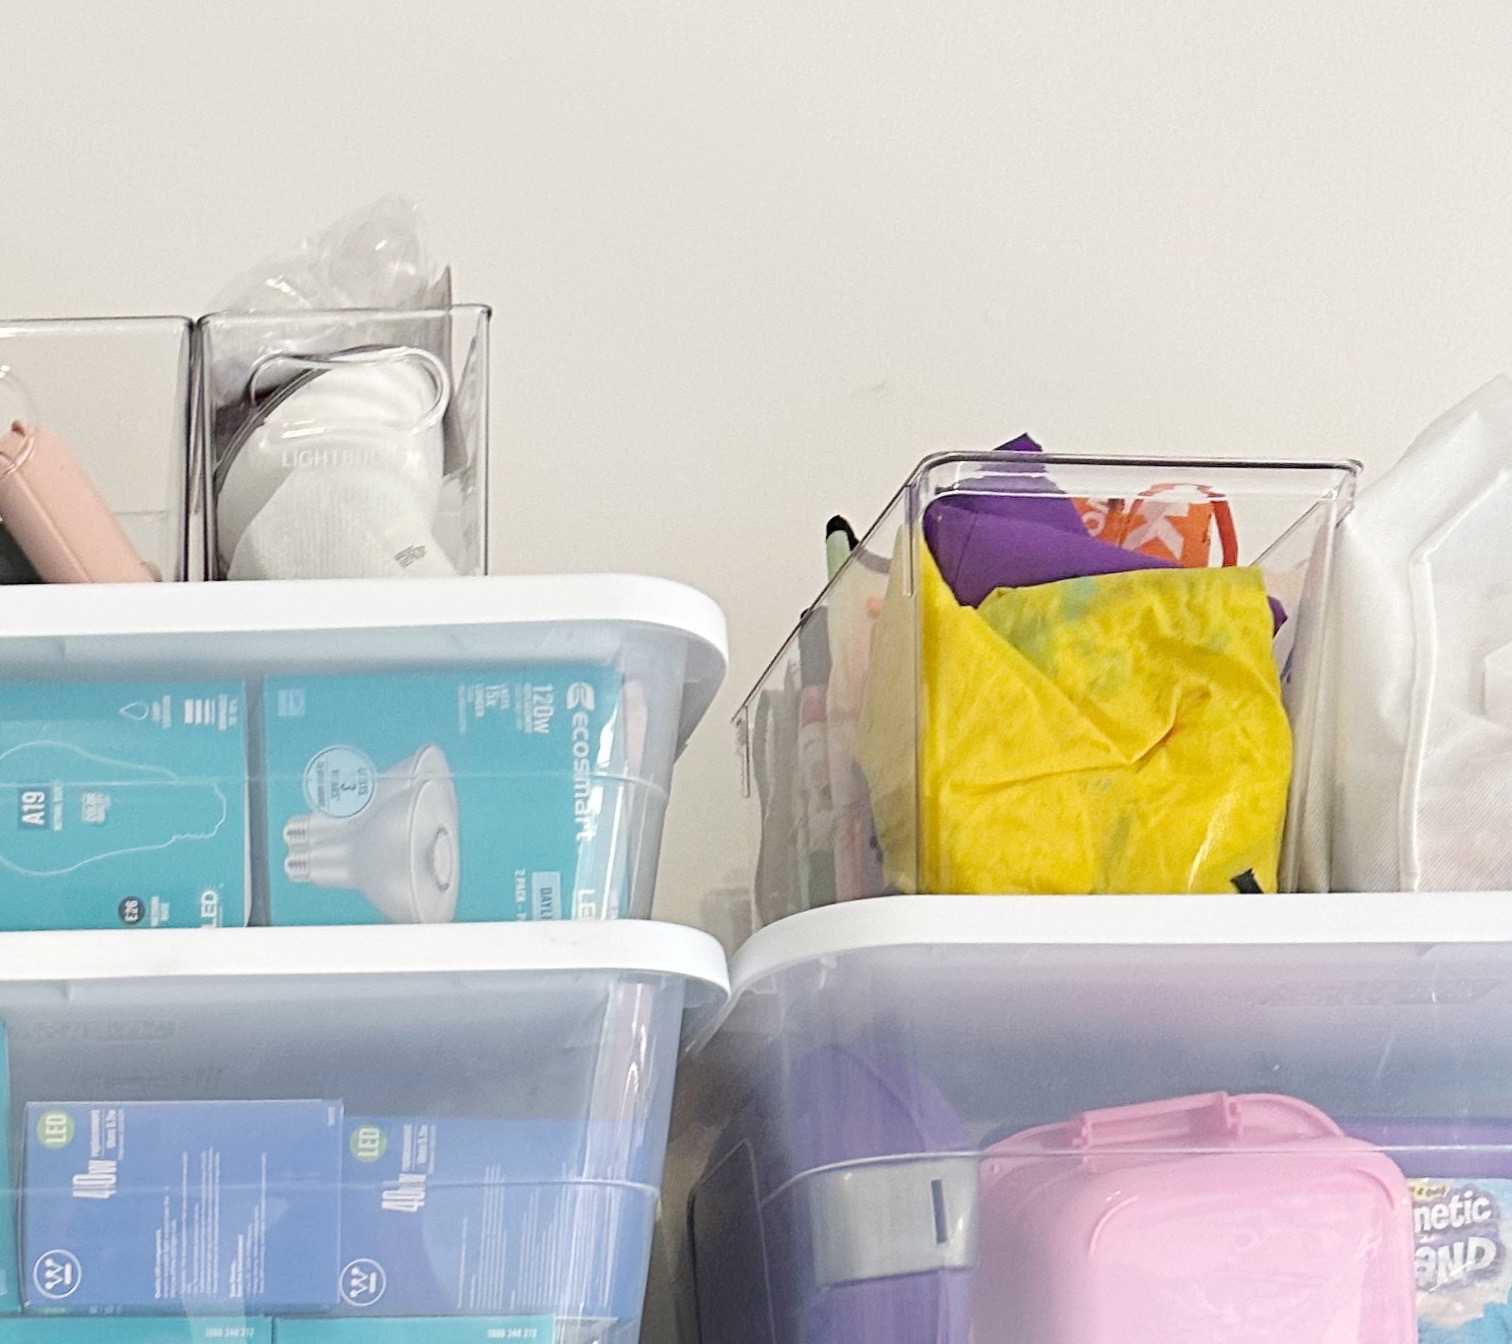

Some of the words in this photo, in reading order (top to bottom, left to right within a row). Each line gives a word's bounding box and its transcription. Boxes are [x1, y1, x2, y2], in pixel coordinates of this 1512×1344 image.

[532, 684, 554, 733] 120w
[571, 712, 596, 841] ecosmart
[22, 791, 45, 826] A19
[201, 890, 217, 928] LED
[577, 888, 595, 919] LE
[45, 1112, 67, 1144] LED
[359, 1128, 380, 1157] LED
